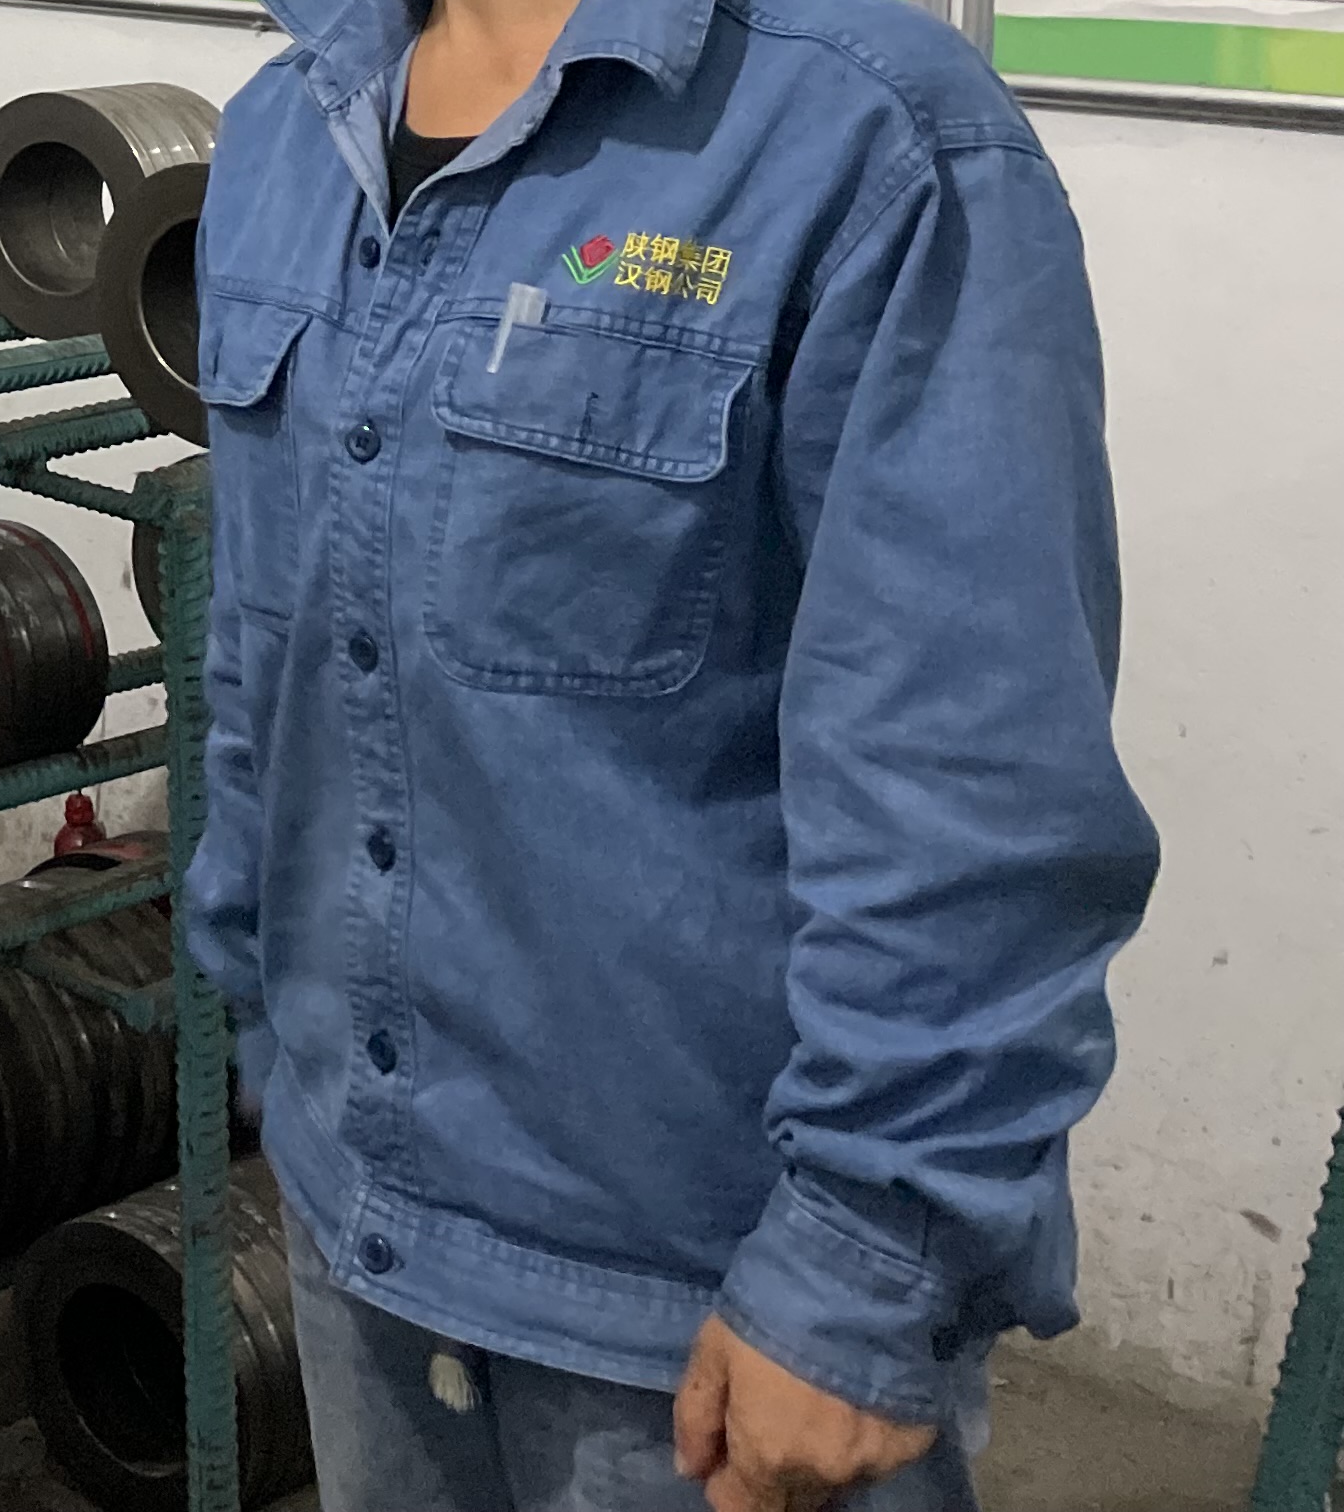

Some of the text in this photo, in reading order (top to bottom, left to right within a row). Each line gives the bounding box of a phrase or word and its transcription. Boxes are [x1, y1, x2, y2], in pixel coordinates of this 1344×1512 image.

[619, 230, 733, 279] 陕钢集团
[613, 260, 724, 306] 汉钢公司
